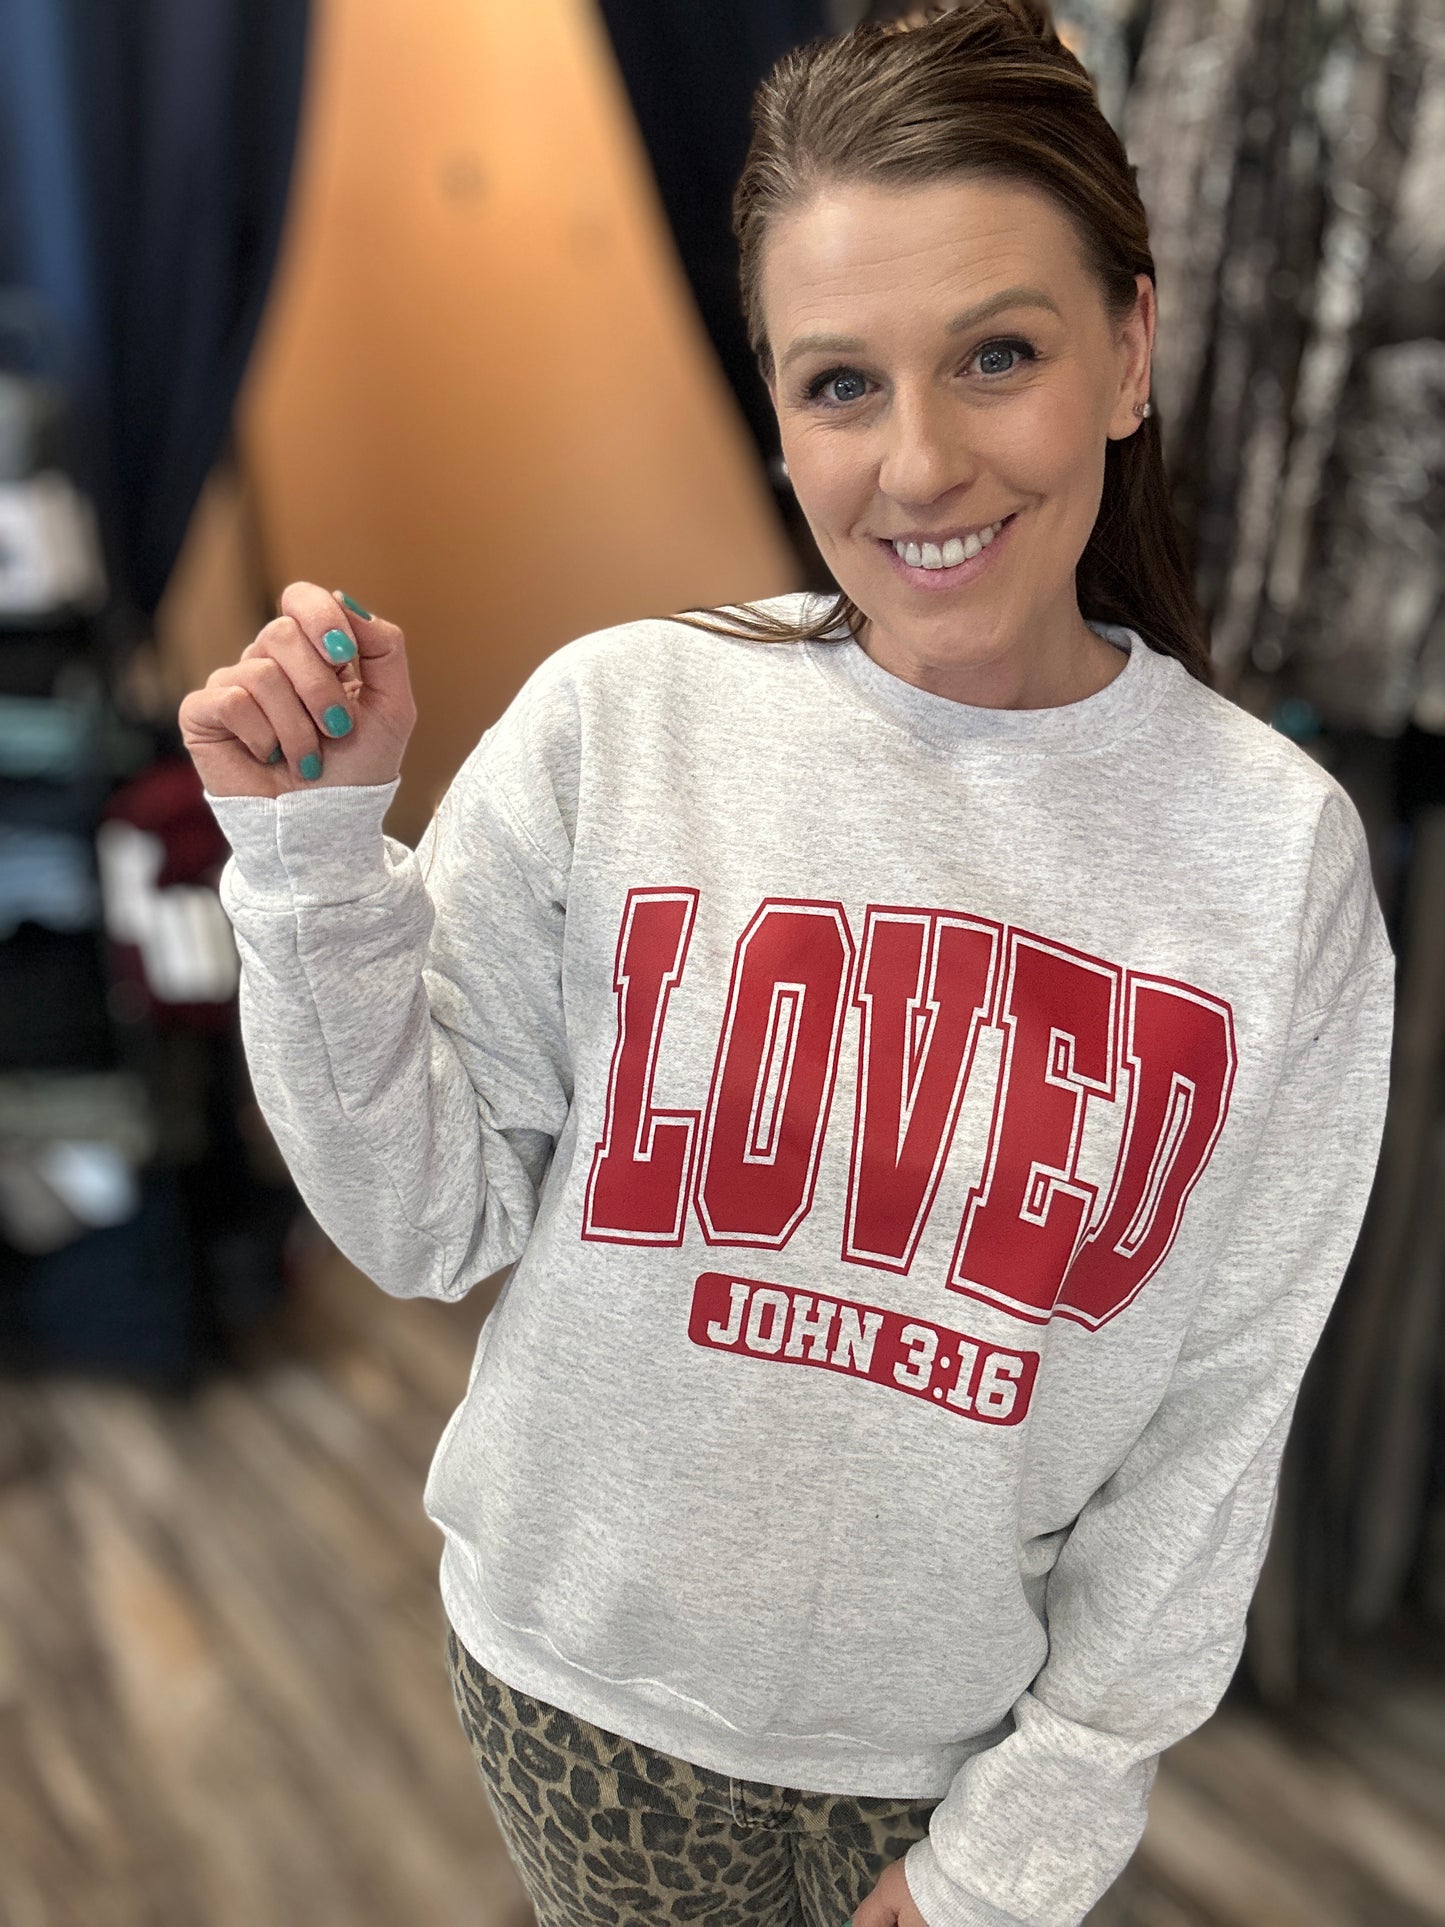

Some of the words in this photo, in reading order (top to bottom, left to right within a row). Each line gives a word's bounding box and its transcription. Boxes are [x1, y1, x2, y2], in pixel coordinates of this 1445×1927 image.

[581, 886, 1238, 1331] LOVED
[706, 1283, 884, 1373] JOHN
[893, 1323, 1023, 1418] 3:16
